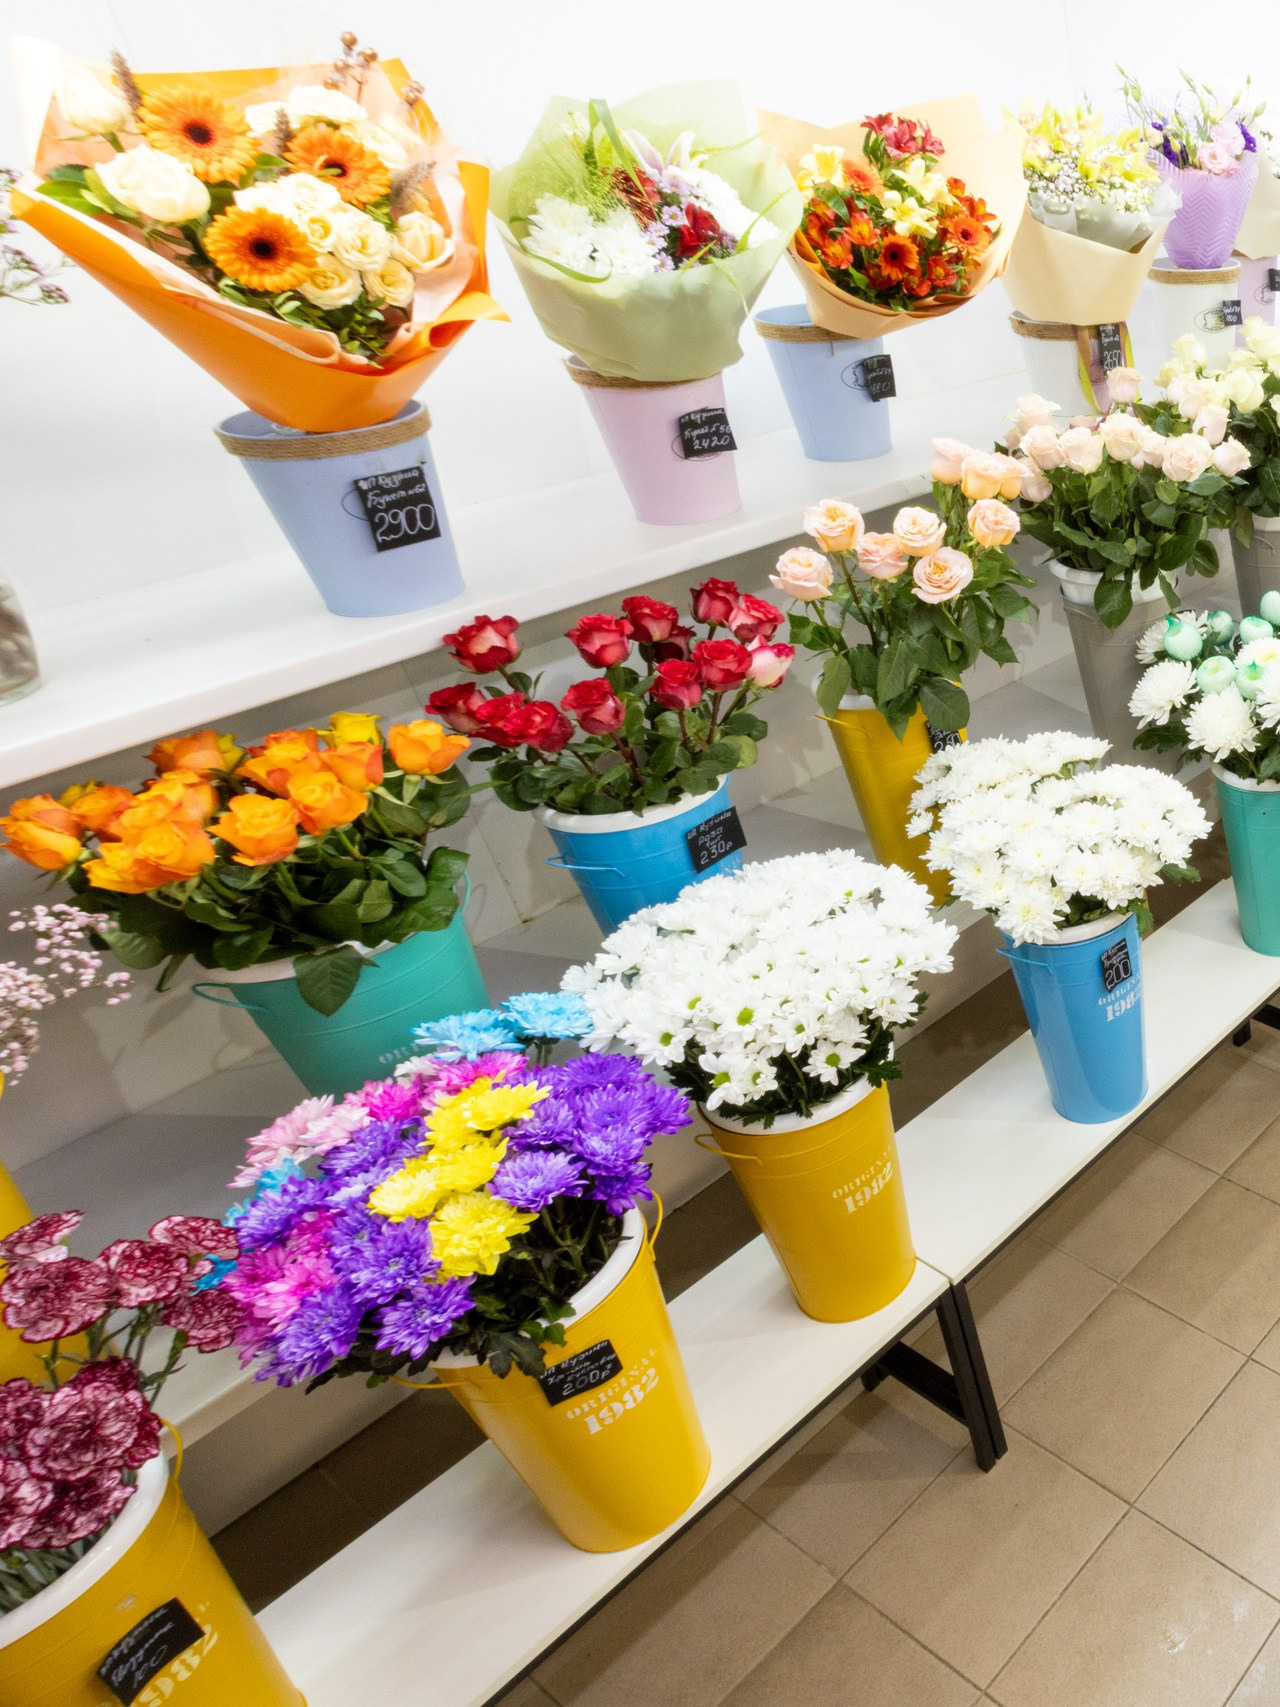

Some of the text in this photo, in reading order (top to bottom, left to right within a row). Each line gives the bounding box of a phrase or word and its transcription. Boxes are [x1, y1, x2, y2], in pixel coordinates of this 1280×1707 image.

[693, 435, 730, 449] 2420
[374, 503, 435, 543] 2900
[1105, 959, 1131, 990] 200
[844, 1161, 893, 1214] 1982
[584, 1368, 659, 1435] 1982
